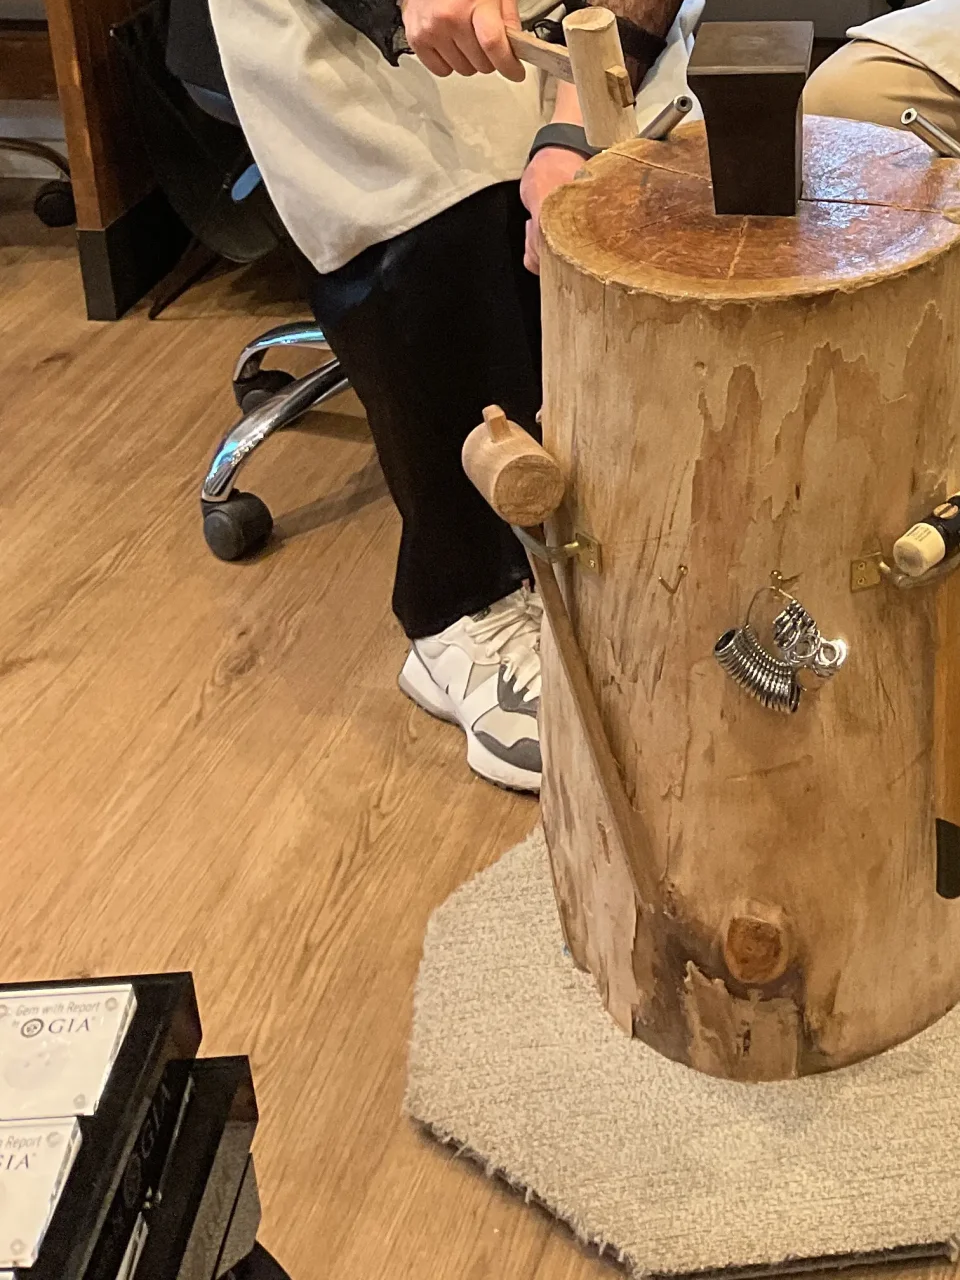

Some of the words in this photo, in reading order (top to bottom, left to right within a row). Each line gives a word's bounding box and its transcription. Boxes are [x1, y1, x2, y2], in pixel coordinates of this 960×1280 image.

[15, 1004, 39, 1017] Gem
[42, 1003, 64, 1014] with
[67, 1001, 100, 1016] Report
[48, 1018, 89, 1034] GIA
[4, 1135, 42, 1151] Report
[0, 1154, 29, 1170] IA
